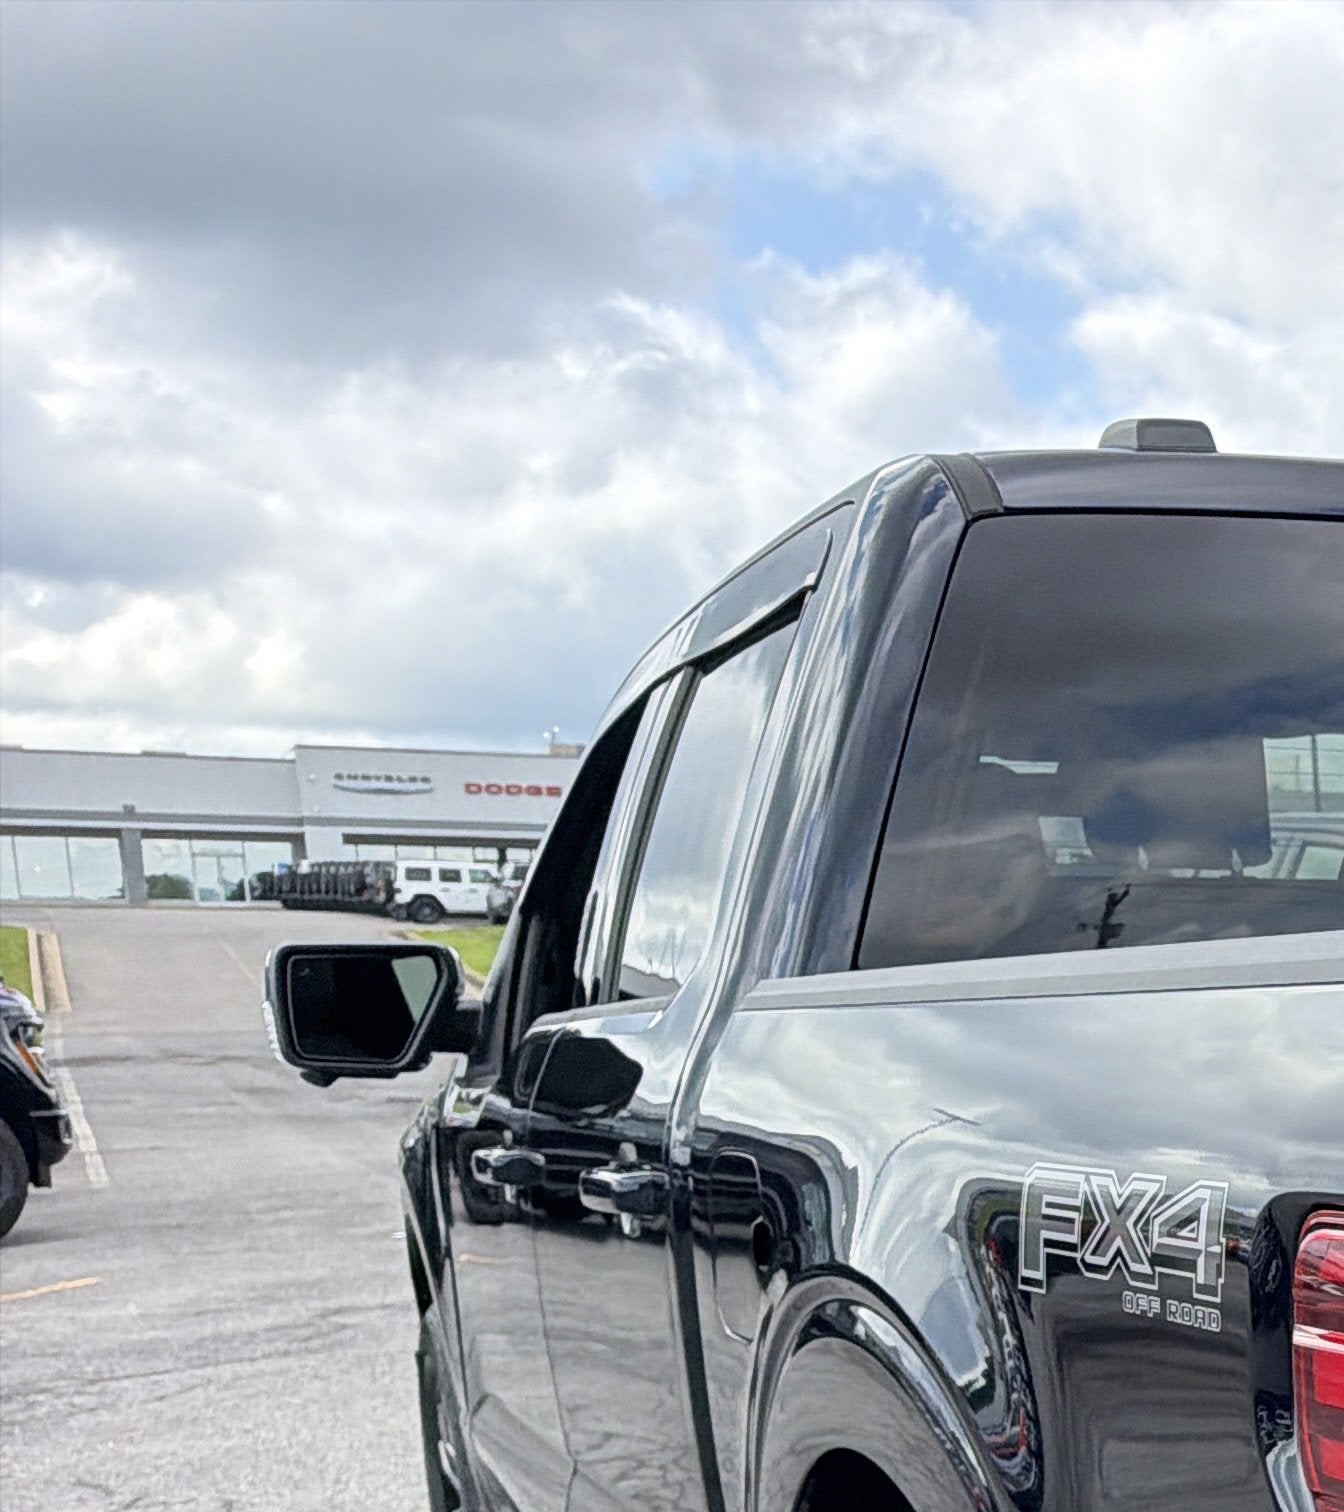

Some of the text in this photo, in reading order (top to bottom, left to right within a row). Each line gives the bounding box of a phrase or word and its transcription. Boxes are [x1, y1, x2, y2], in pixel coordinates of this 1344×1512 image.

[464, 782, 562, 797] DODGE
[1018, 1161, 1230, 1303] FX4
[1122, 1291, 1221, 1332] OFF ROAD
